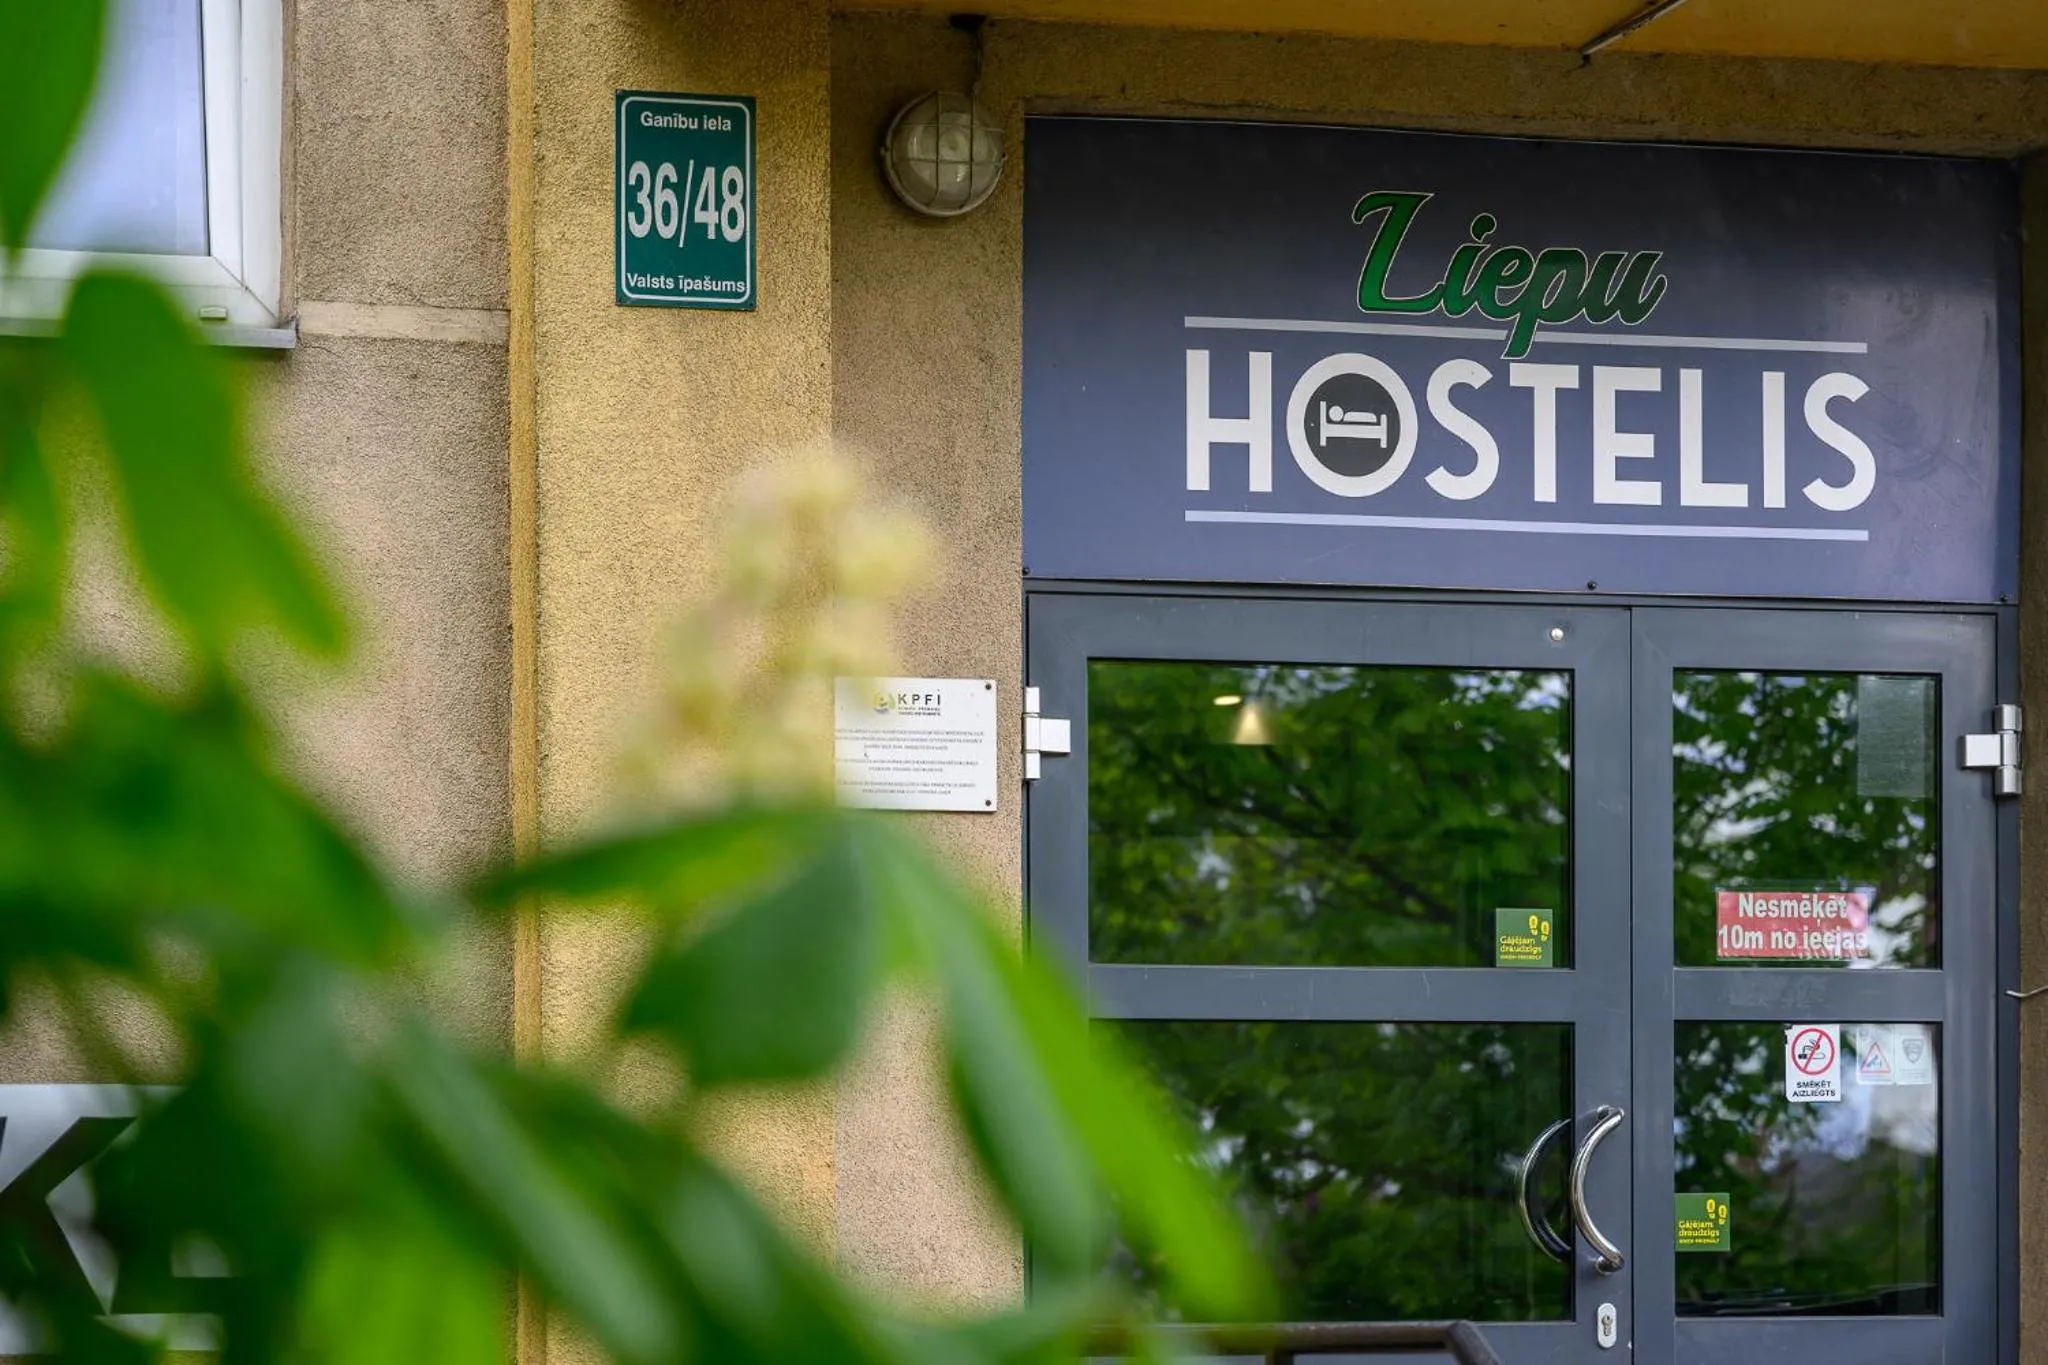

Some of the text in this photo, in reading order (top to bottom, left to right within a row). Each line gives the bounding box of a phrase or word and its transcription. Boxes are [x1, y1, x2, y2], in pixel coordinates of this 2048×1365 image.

[640, 111, 731, 131] Ganību iela
[627, 159, 745, 248] 36/48
[627, 272, 746, 293] Valsts īpašums
[1351, 189, 1668, 359] Liepu
[1185, 349, 1877, 512] HOSTELIS
[1719, 924, 1763, 949] 10m
[1771, 930, 1796, 949] no
